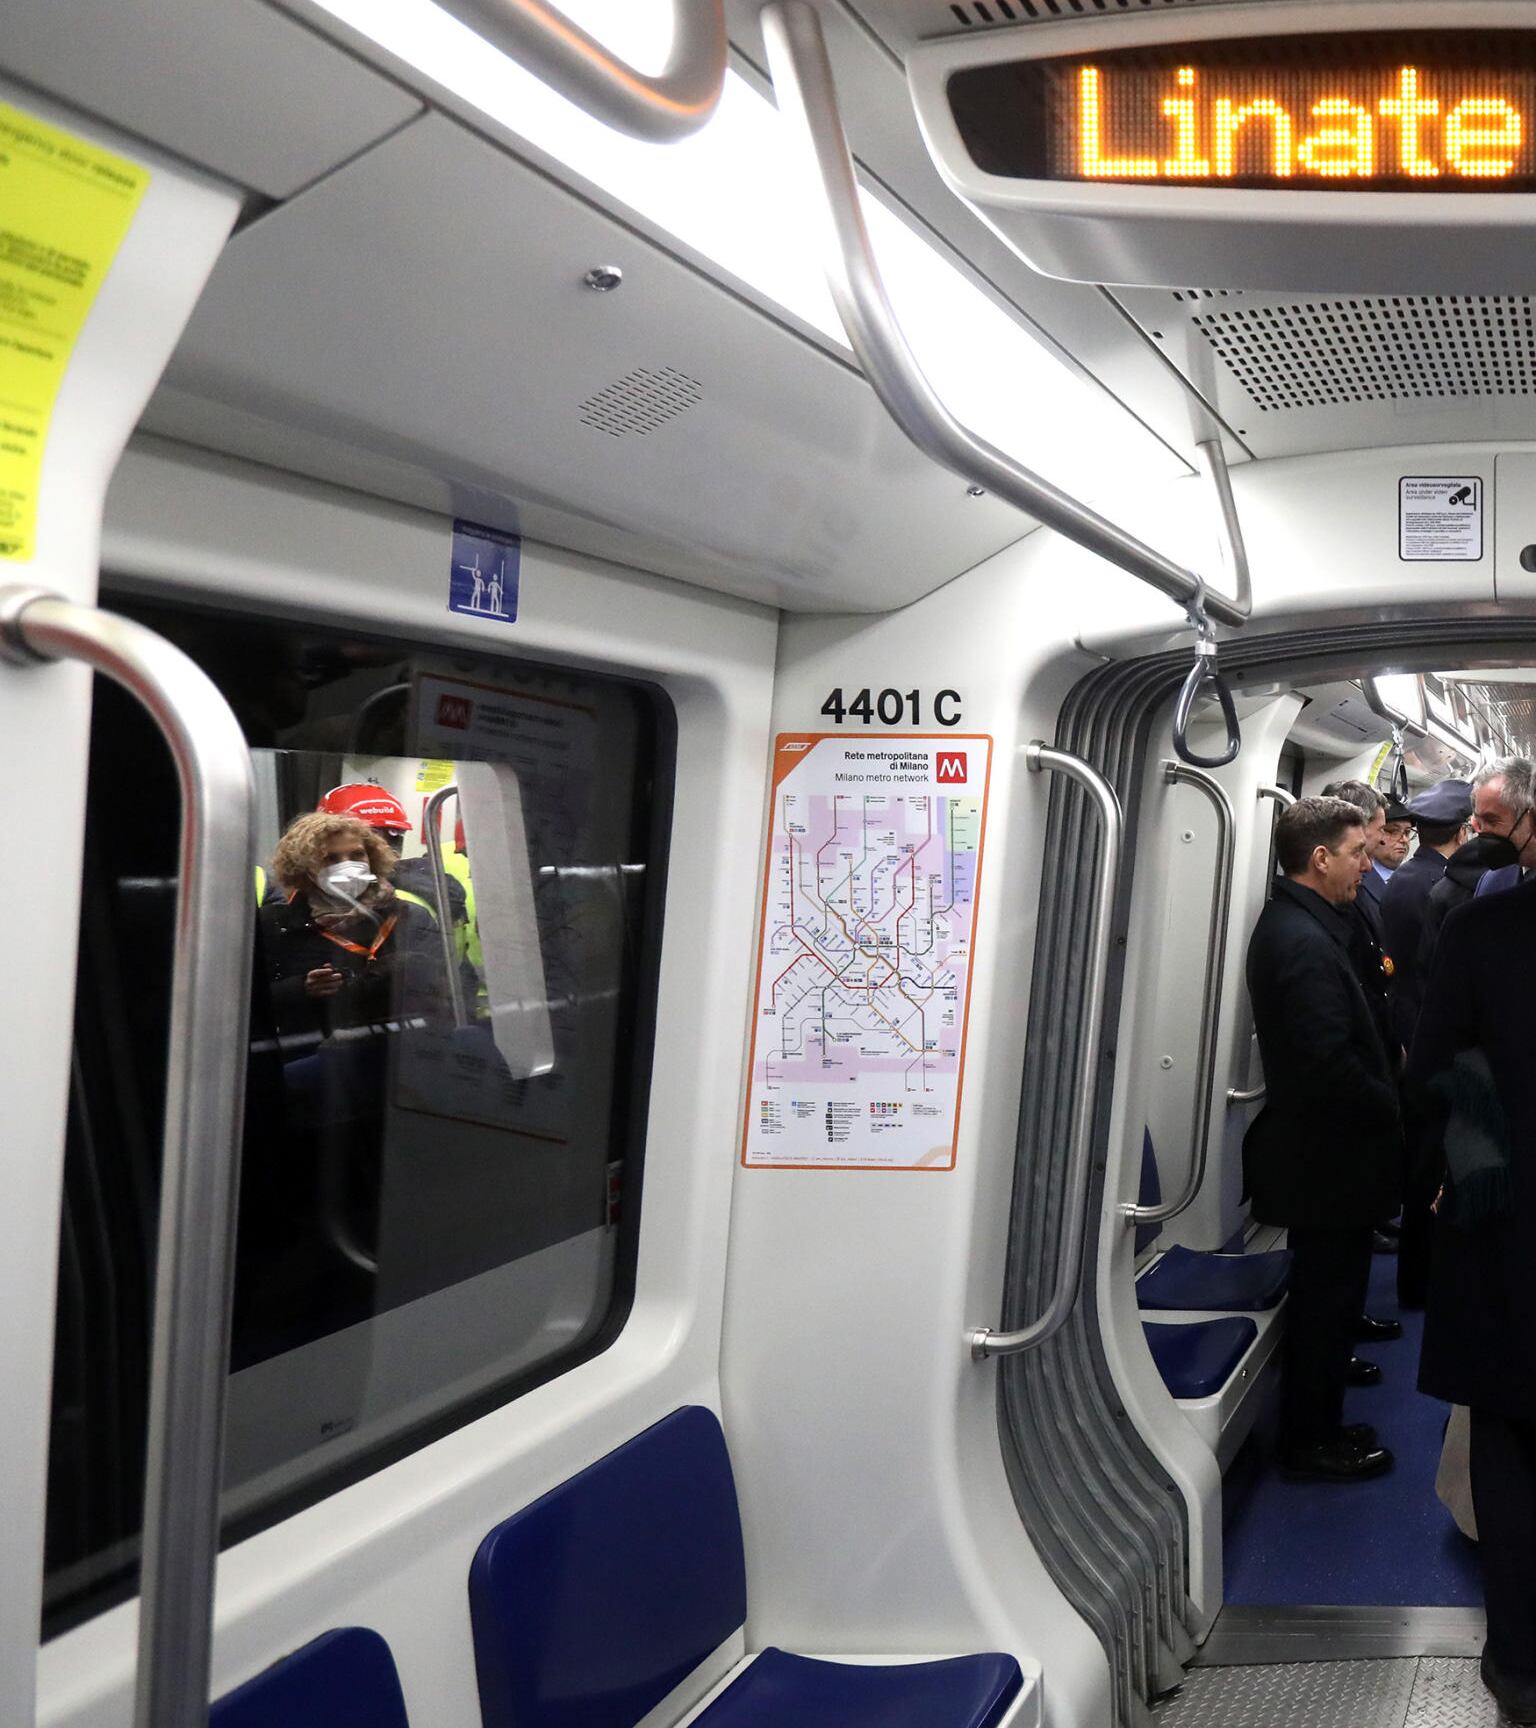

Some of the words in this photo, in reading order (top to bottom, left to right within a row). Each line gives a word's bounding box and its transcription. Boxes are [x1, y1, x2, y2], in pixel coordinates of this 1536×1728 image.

[1081, 66, 1522, 177] Linate
[820, 687, 920, 726] 4401
[933, 689, 962, 727] C
[844, 751, 865, 761] Rete
[866, 751, 929, 763] metropolitana
[889, 761, 898, 771] di
[899, 762, 929, 771] Milano
[939, 758, 966, 778] M
[835, 773, 865, 783] Milano
[865, 774, 892, 783] metro
[894, 773, 930, 783] network
[359, 806, 395, 815] webuild
